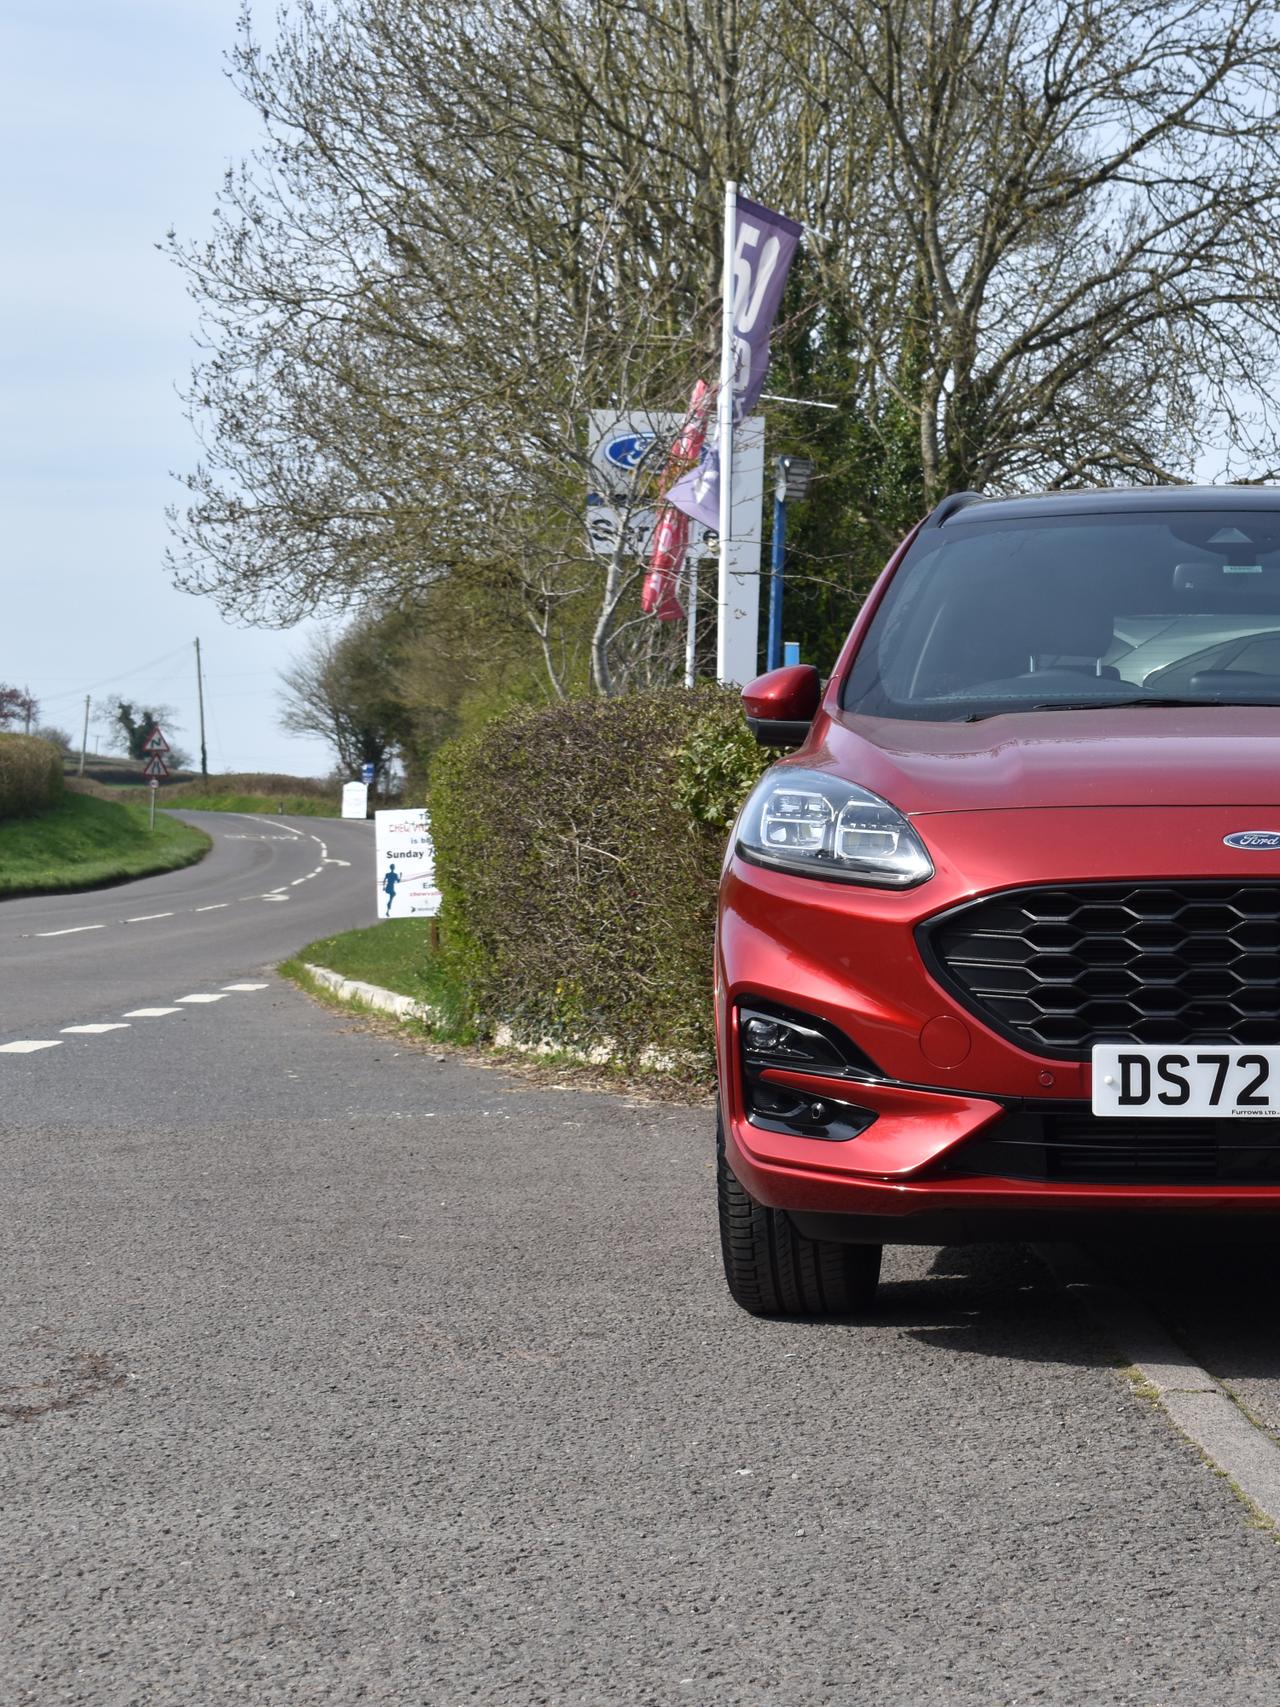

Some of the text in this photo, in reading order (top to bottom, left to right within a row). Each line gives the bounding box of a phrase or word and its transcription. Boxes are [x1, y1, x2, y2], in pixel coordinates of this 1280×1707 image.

[1240, 833, 1280, 845] Ford
[386, 850, 425, 860] Sunday
[1118, 1054, 1270, 1106] DS72
